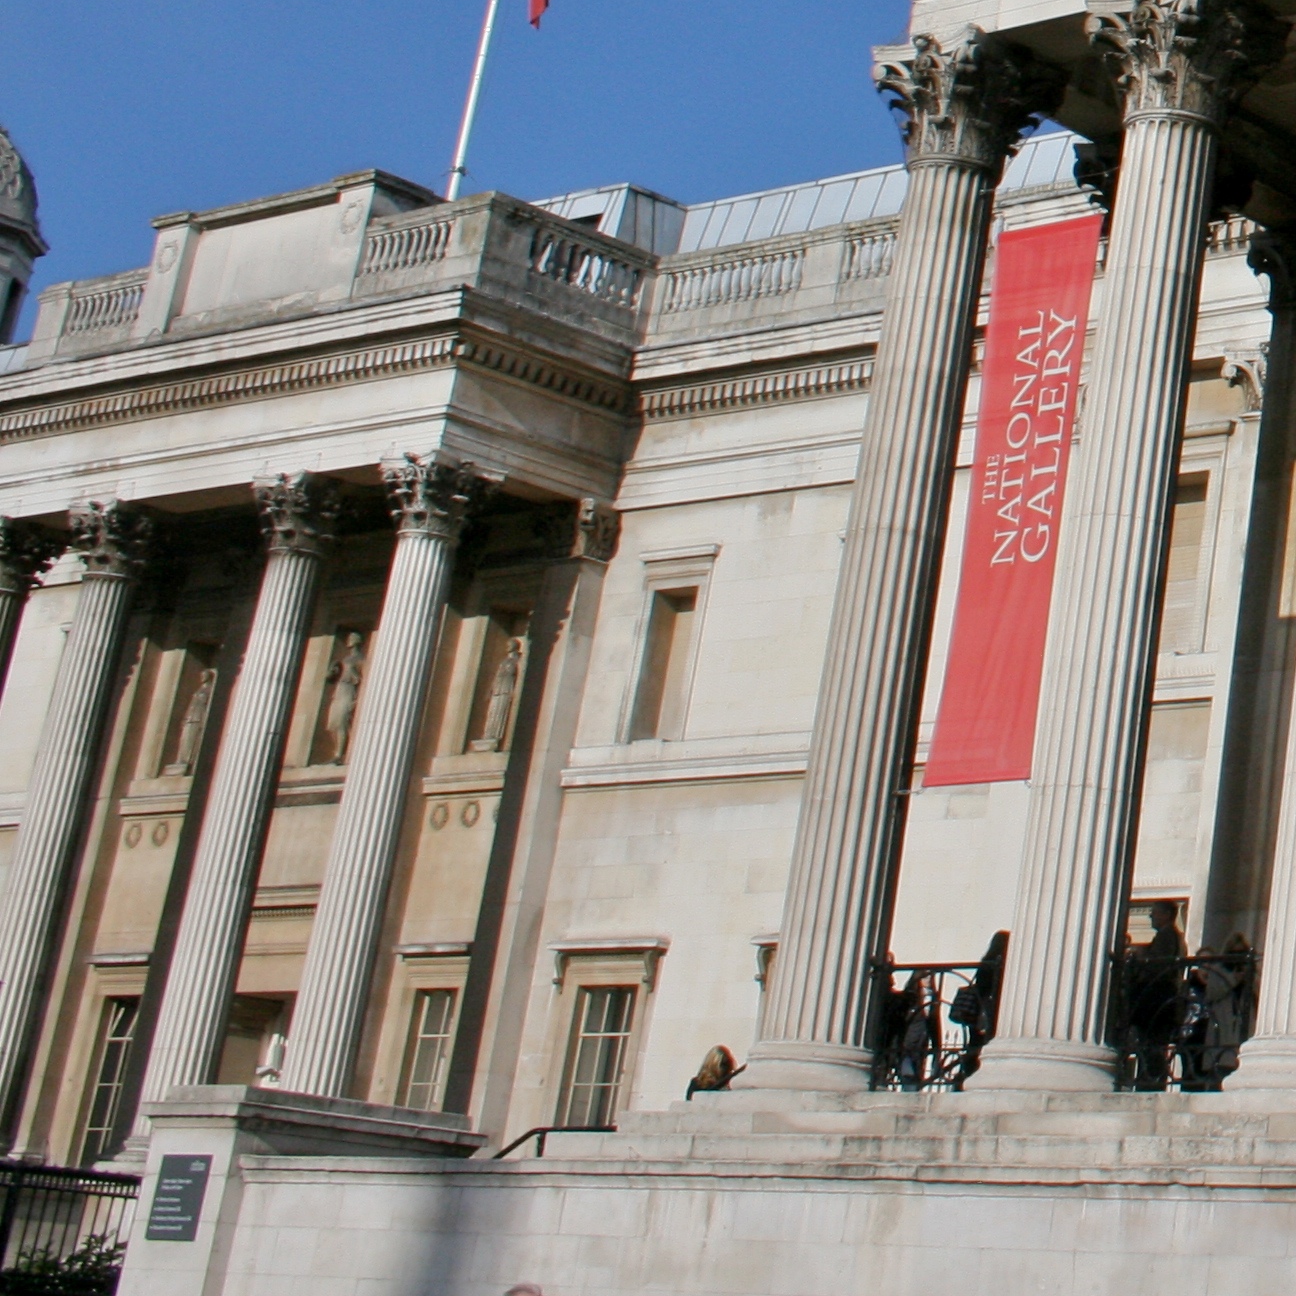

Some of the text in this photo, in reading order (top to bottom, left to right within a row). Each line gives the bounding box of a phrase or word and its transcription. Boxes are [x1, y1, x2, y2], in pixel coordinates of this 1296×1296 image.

[982, 453, 1000, 504] THE
[990, 310, 1045, 567] NATIONAL
[1020, 308, 1077, 563] GALLERY
